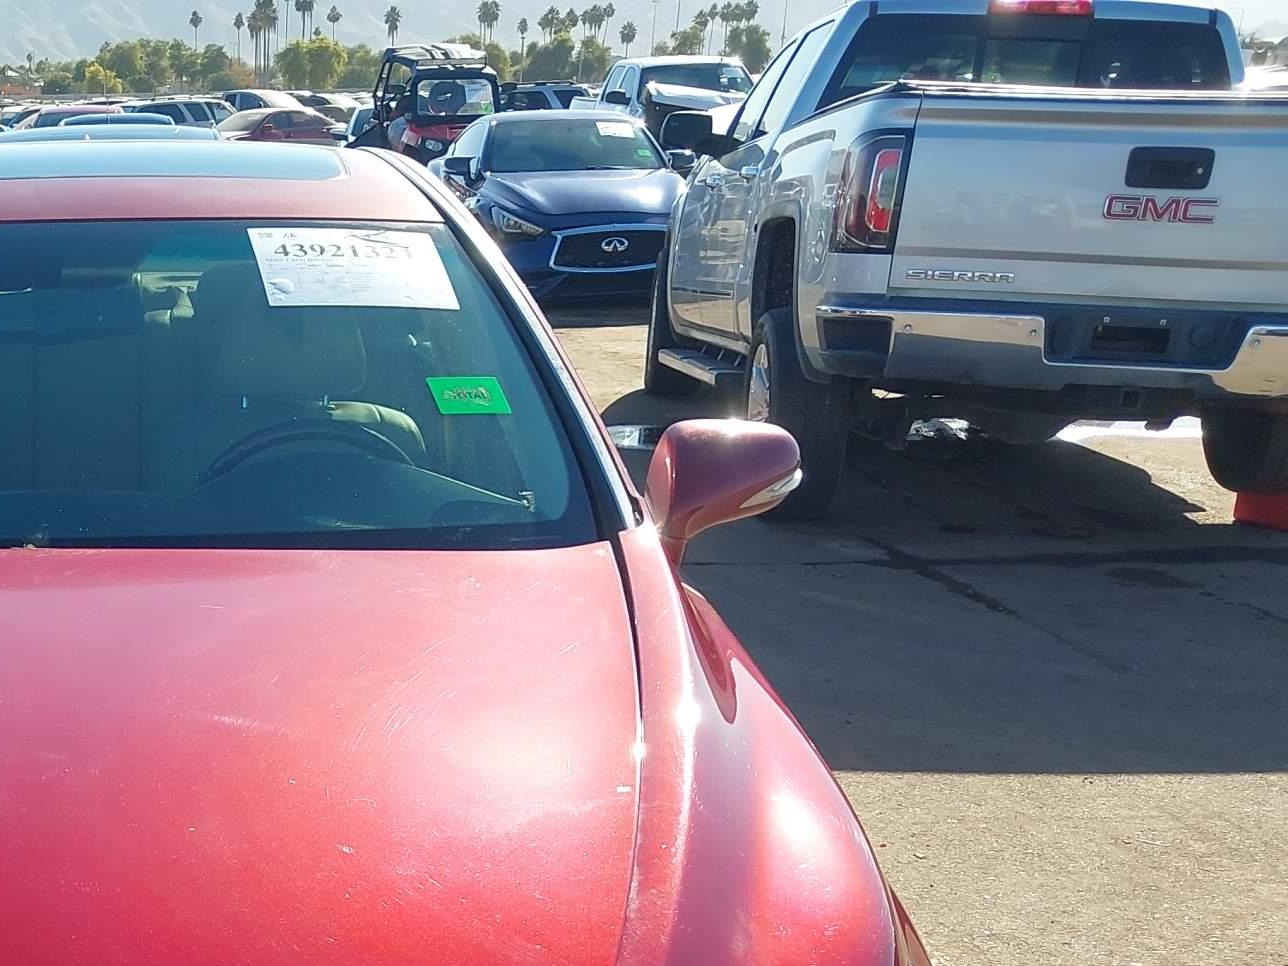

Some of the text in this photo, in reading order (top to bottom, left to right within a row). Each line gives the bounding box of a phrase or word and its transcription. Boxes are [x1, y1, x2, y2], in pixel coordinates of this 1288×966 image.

[1103, 194, 1220, 224] GMC
[273, 243, 412, 259] 43921321
[905, 268, 1015, 284] SIERRA
